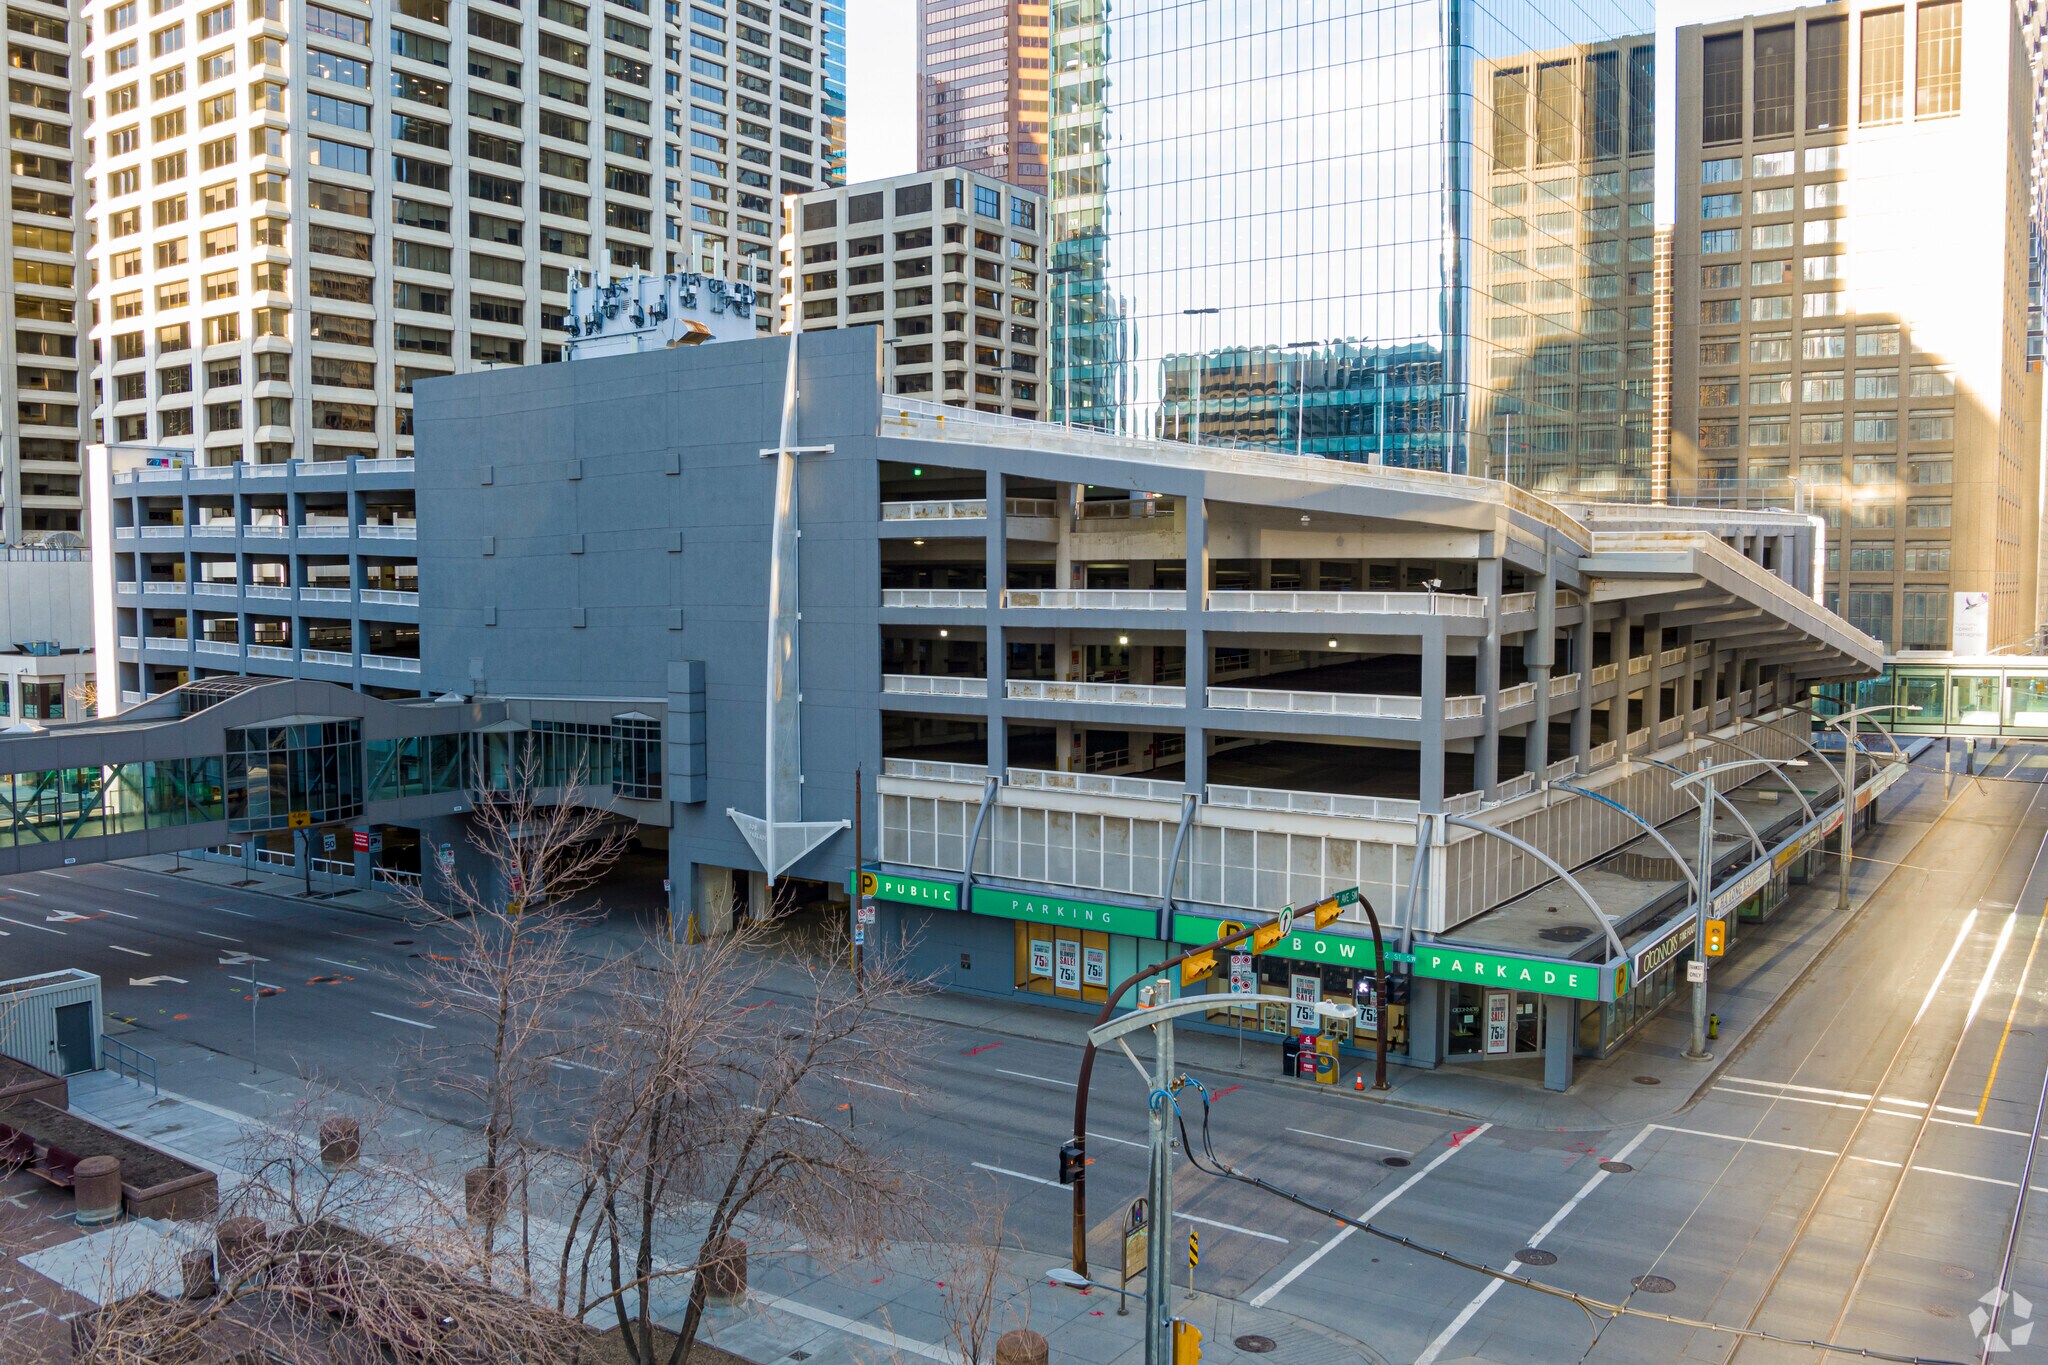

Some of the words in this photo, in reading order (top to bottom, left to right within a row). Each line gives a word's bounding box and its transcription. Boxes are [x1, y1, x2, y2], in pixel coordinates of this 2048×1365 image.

[325, 840, 335, 849] 50
[862, 875, 873, 893] P
[886, 882, 951, 901] PUBLIC
[1340, 893, 1350, 904] AVE
[1351, 890, 1358, 901] SW
[1012, 900, 1111, 923] PARKING
[1293, 938, 1356, 958] BOW
[1059, 956, 1076, 966] SALE!
[1432, 956, 1578, 987] PARKADE
[1617, 967, 1624, 993] P
